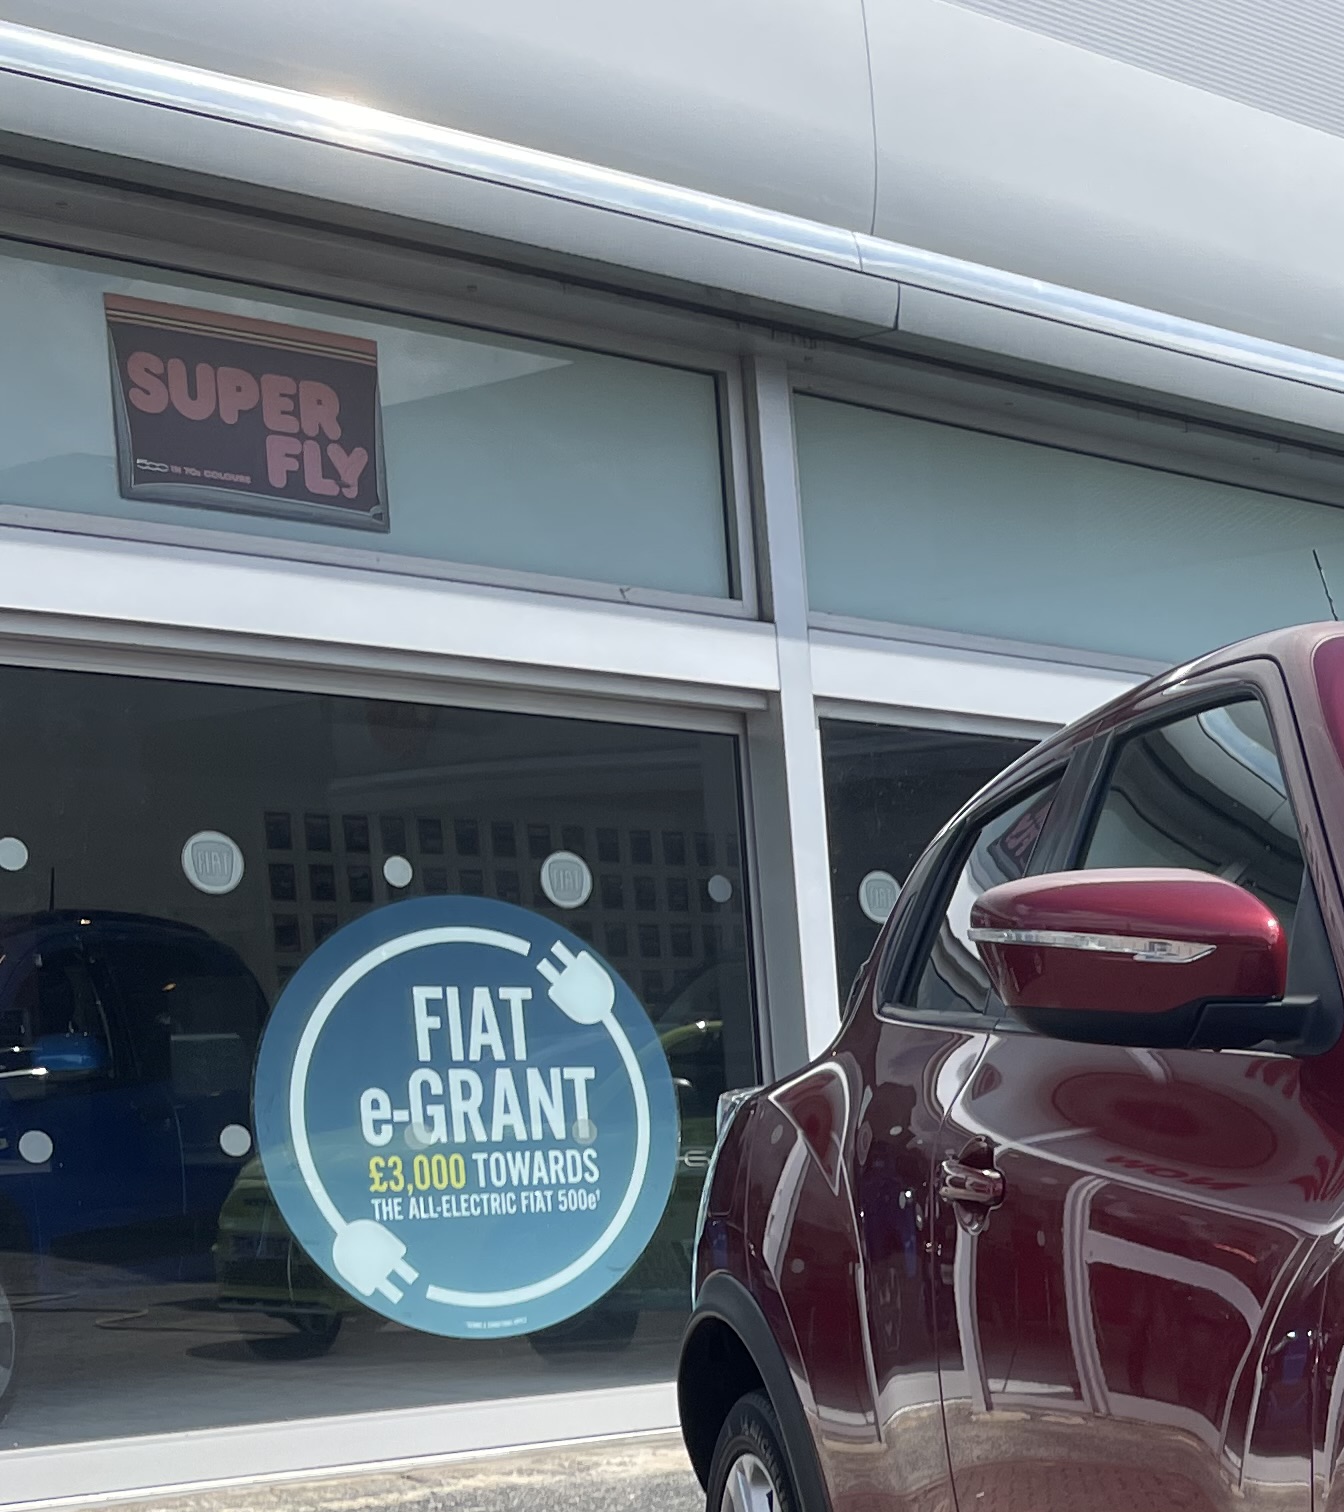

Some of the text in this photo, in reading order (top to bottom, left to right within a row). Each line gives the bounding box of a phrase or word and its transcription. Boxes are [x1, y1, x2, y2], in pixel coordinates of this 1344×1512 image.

[127, 351, 342, 440] SUPER
[265, 434, 369, 499] FLY
[411, 985, 534, 1062] FIAT
[359, 1066, 597, 1147] e-GRANT
[368, 1148, 600, 1197] £3,000 TOWARDS
[370, 1197, 404, 1222] THE
[407, 1193, 518, 1220] ALL-ELECTRIC
[520, 1190, 554, 1214] FIAT
